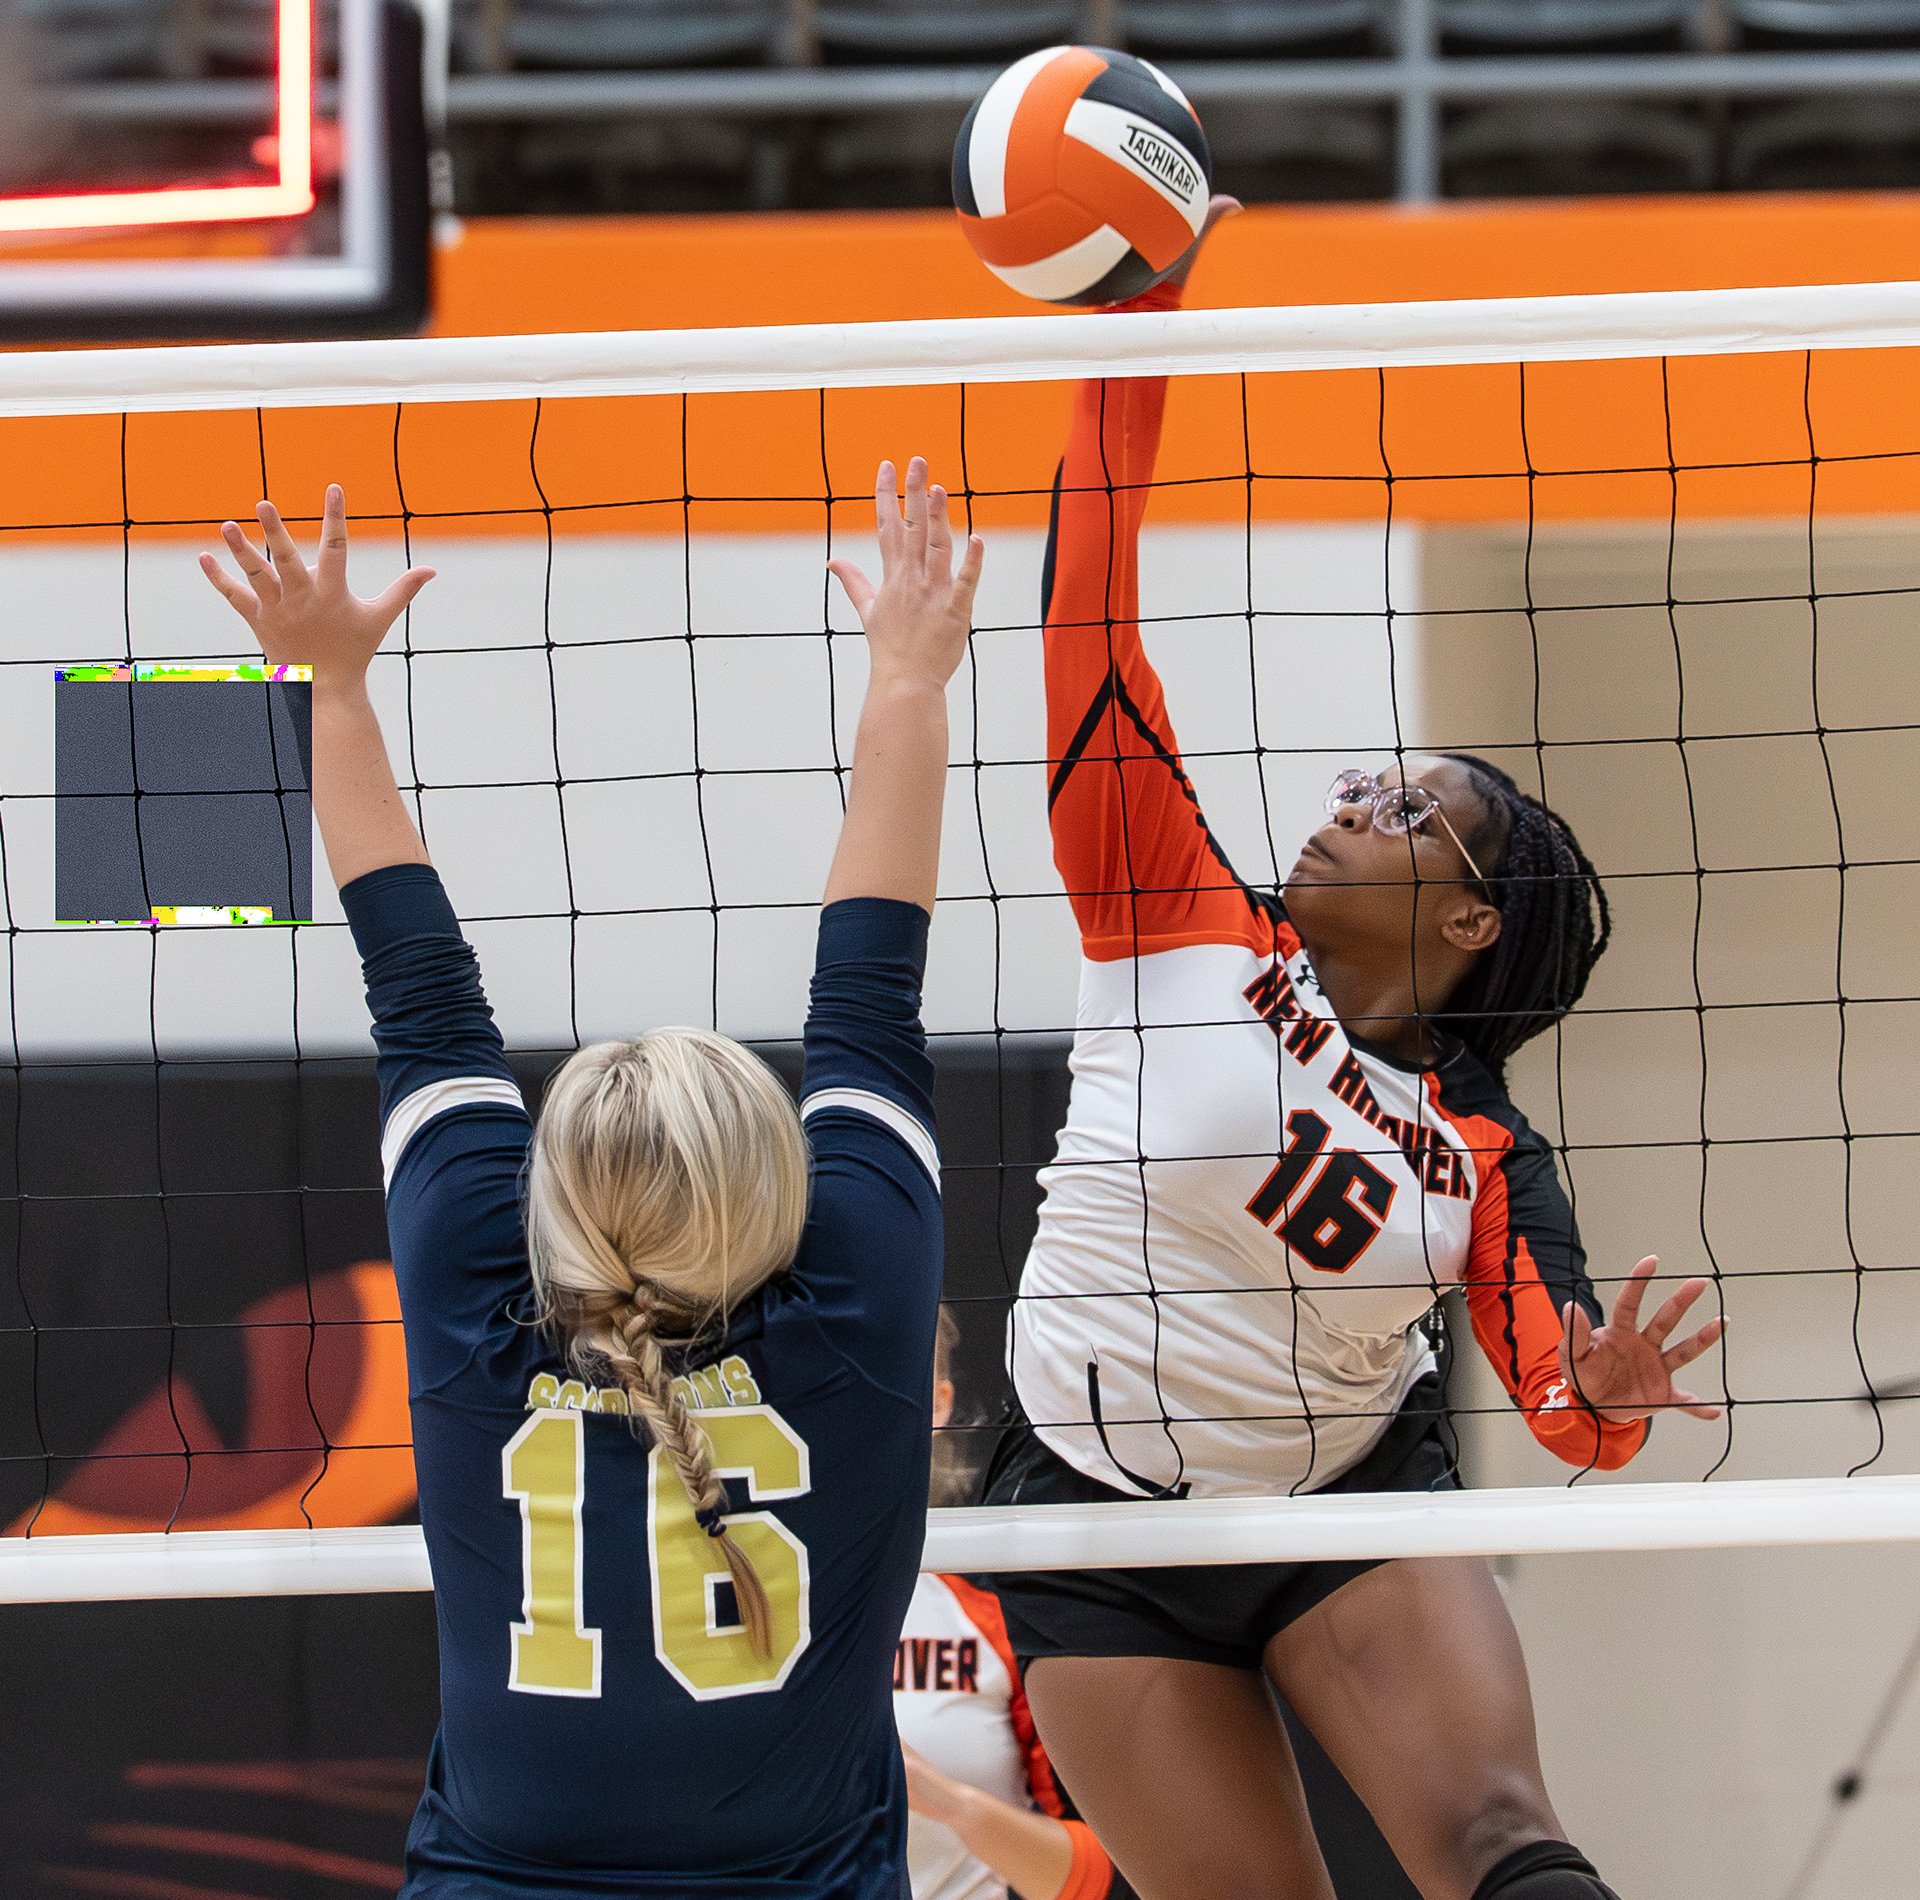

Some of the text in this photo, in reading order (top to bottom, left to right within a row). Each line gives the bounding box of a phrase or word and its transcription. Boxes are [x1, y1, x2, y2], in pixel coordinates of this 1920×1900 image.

[1125, 124, 1199, 196] TACHIKARA
[1242, 961, 1336, 1067] NEW
[1244, 1108, 1398, 1274] 16
[502, 1404, 811, 1701] 16
